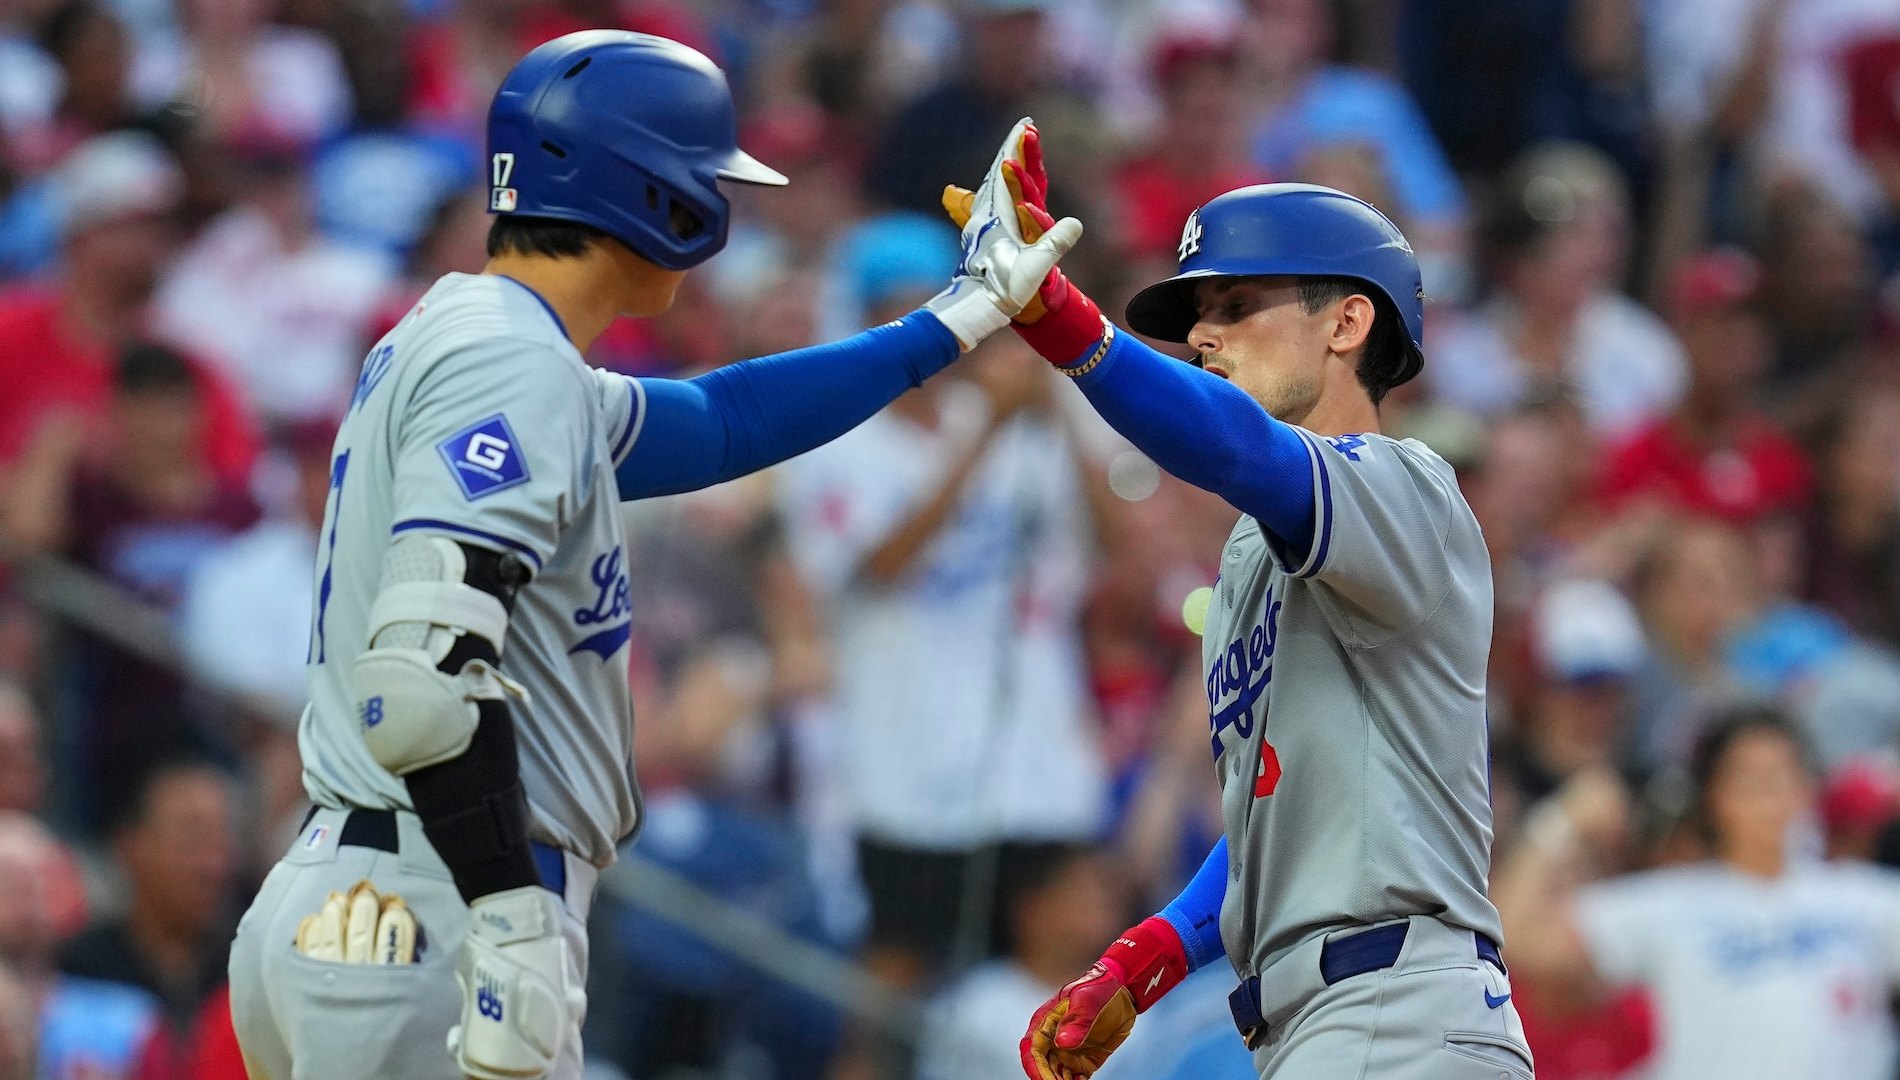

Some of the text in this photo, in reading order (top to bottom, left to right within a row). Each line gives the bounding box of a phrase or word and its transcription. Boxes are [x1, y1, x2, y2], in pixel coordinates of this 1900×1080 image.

[492, 152, 515, 188] 17
[1177, 206, 1203, 262] LA
[465, 432, 510, 471] G
